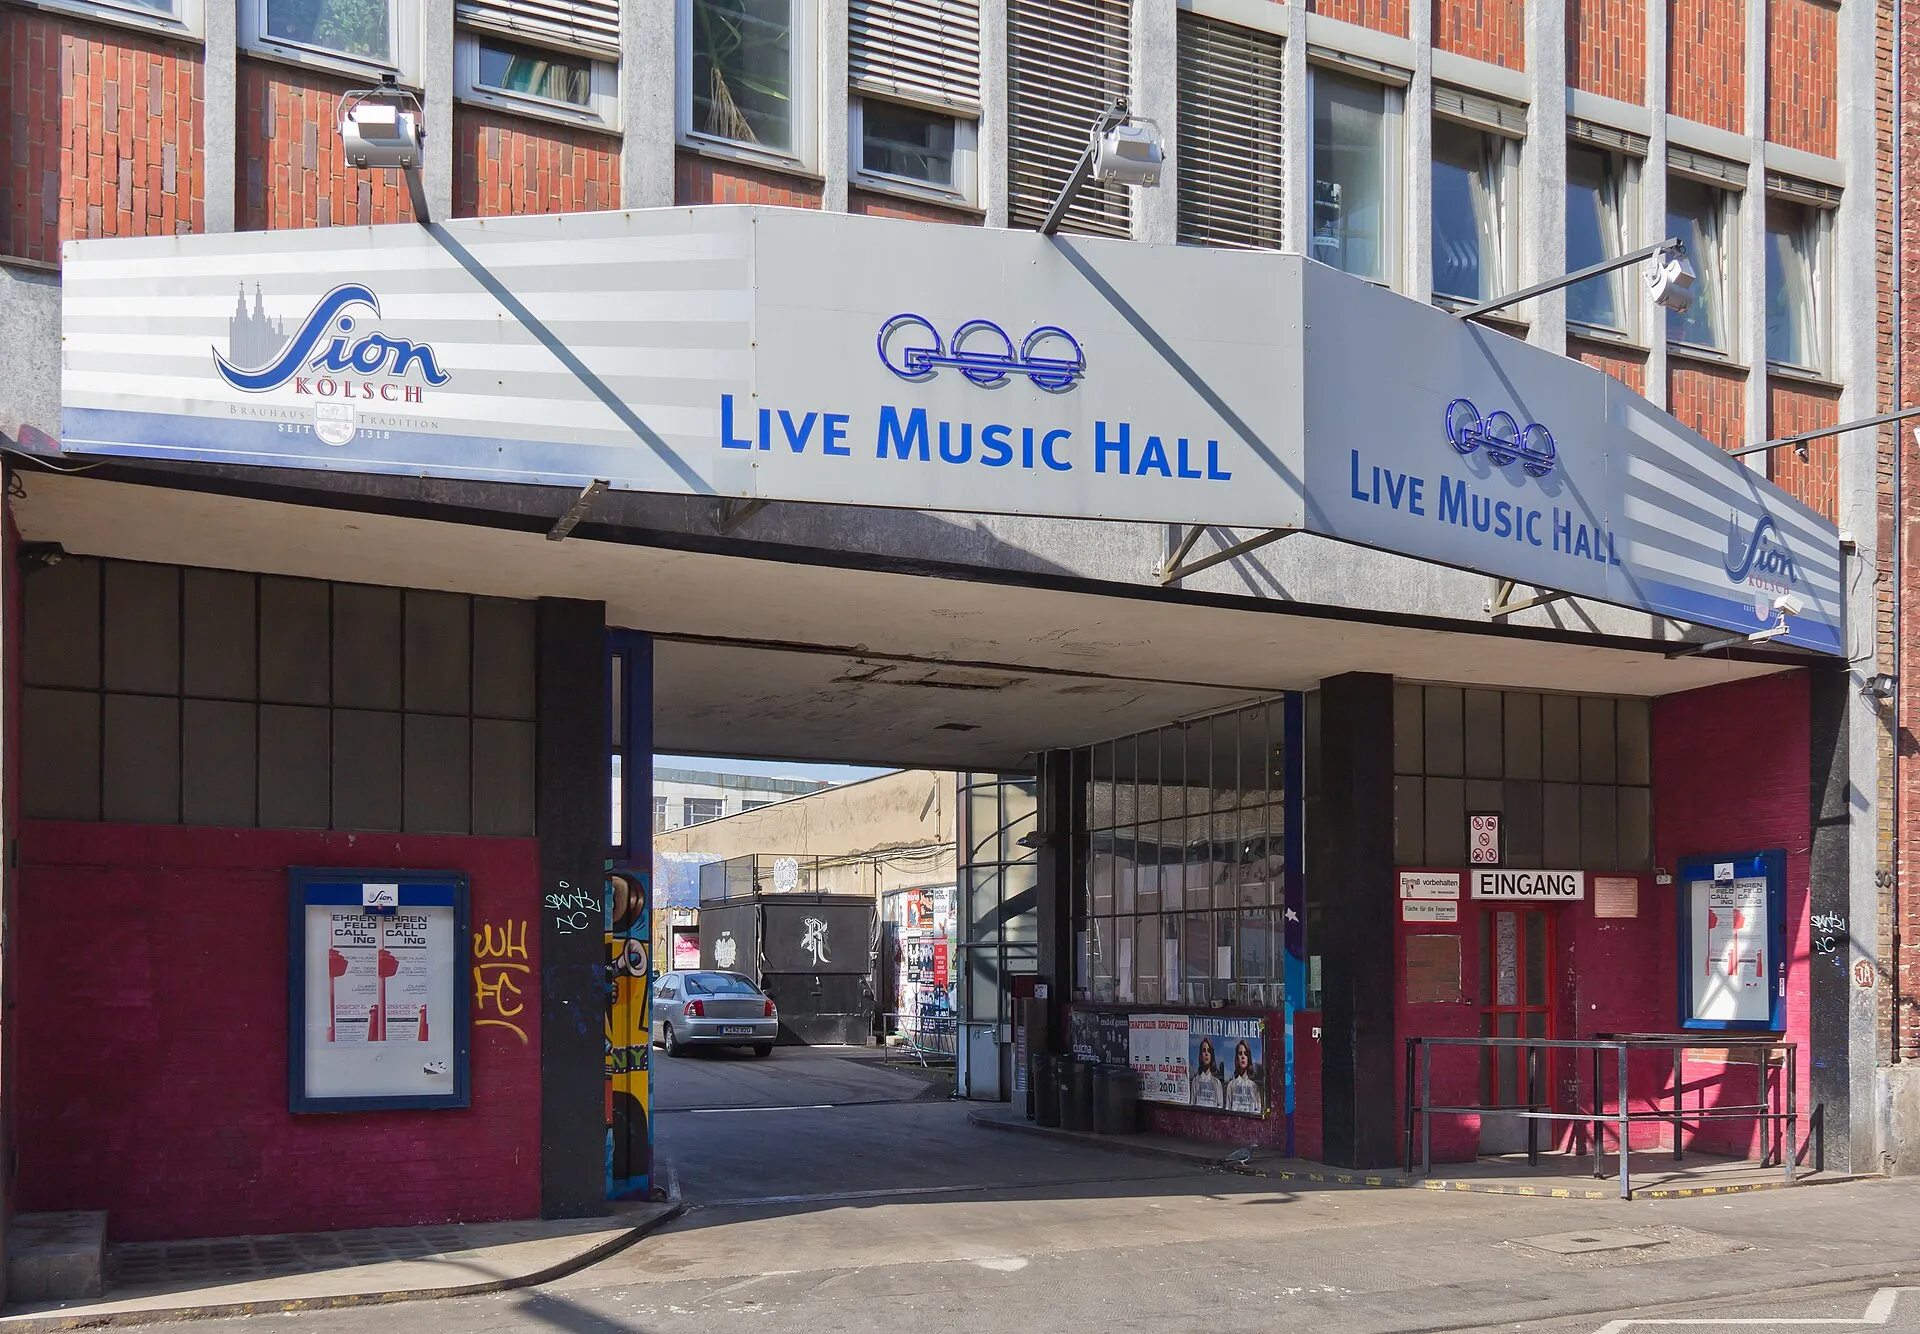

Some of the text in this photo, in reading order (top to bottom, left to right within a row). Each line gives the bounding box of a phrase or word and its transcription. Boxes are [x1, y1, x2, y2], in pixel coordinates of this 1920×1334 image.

[211, 283, 452, 393] Sion
[295, 375, 424, 404] KÖLSCH
[278, 423, 391, 440] SEIT 1318
[1722, 512, 1798, 584] Sion
[1748, 575, 1790, 595] KÖLSCH
[1422, 878, 1458, 886] vorbehalten
[1480, 873, 1576, 896] EINGANG
[1875, 870, 1892, 888] 30
[368, 890, 393, 903] Sion
[333, 914, 377, 922] EHREN
[384, 914, 428, 923] EHREN
[1190, 1018, 1223, 1036] LANA DEL REY
[1225, 1020, 1261, 1038] LANA DEL REY
